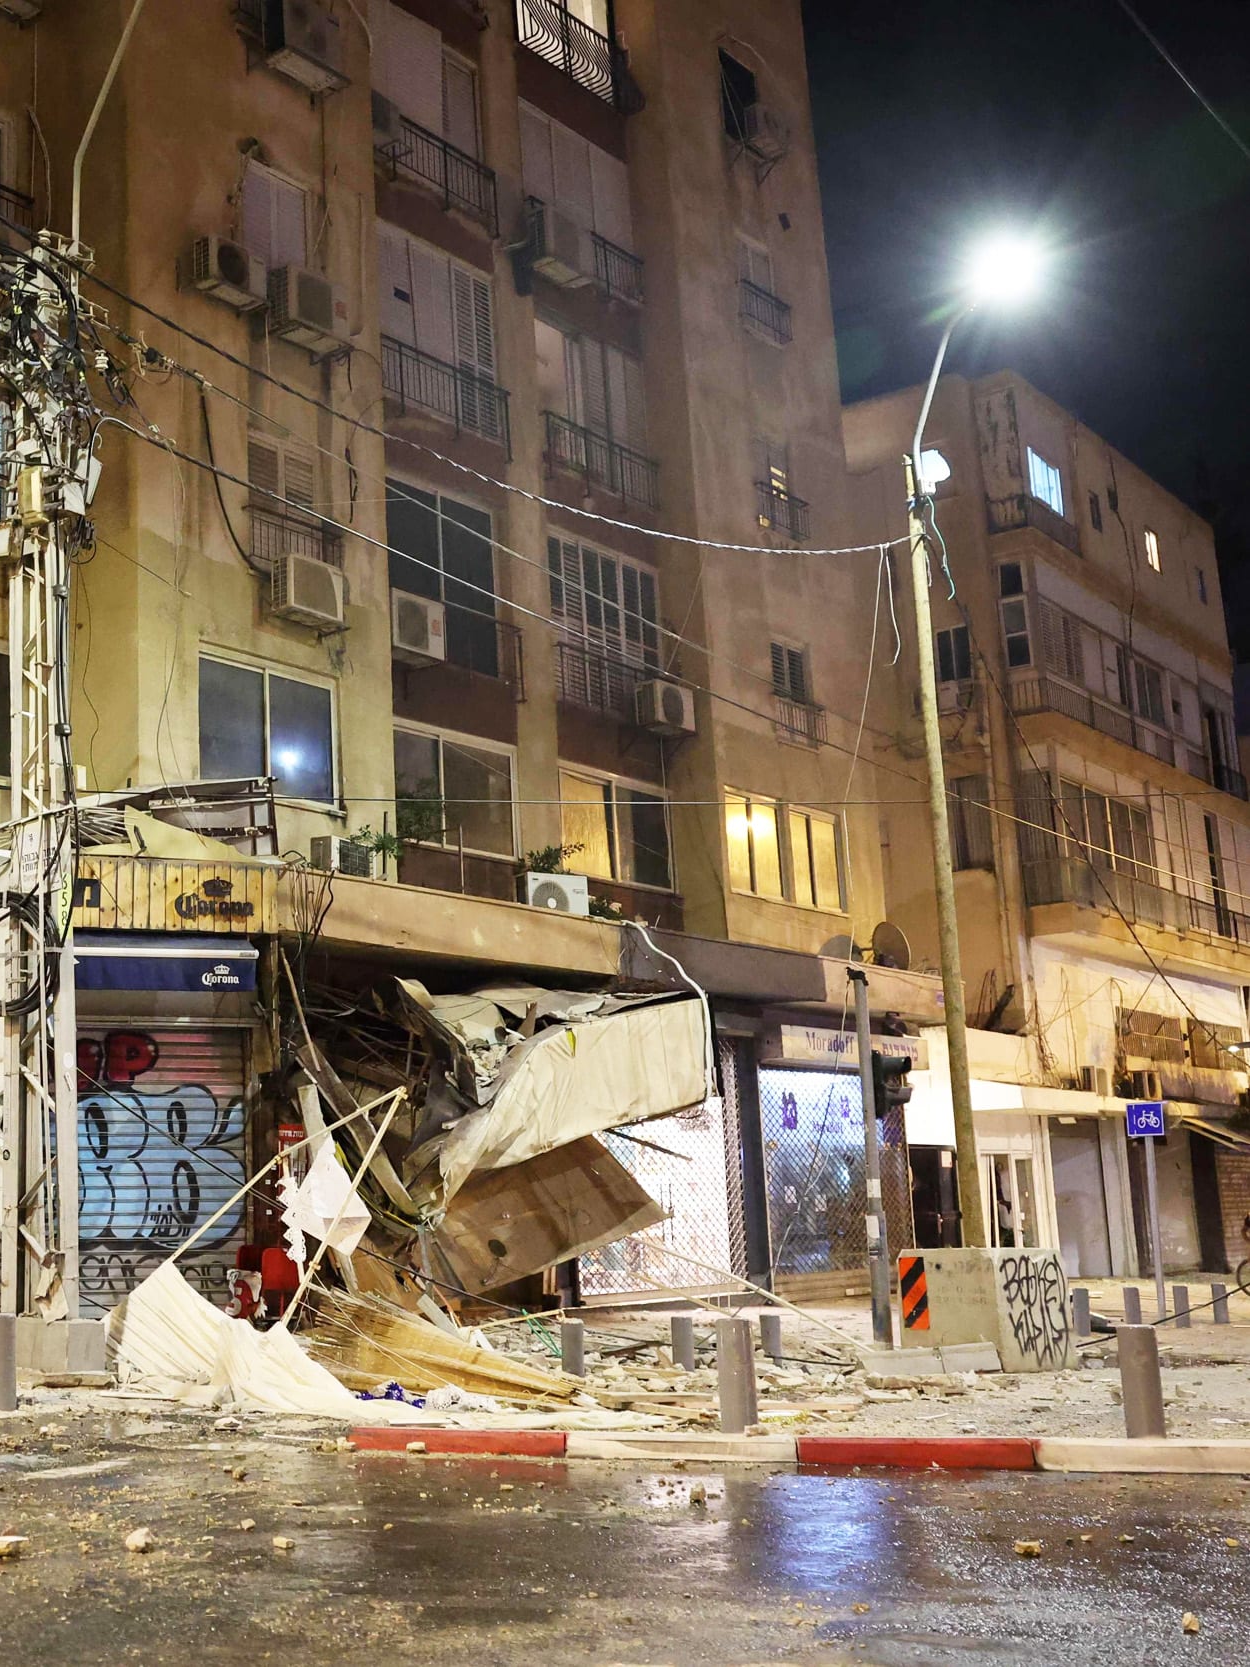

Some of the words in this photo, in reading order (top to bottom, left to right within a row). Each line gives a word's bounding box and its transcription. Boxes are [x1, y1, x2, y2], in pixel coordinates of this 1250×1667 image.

[174, 892, 254, 922] Corona
[201, 972, 240, 987] Corona
[805, 1031, 855, 1055] Moradoff
